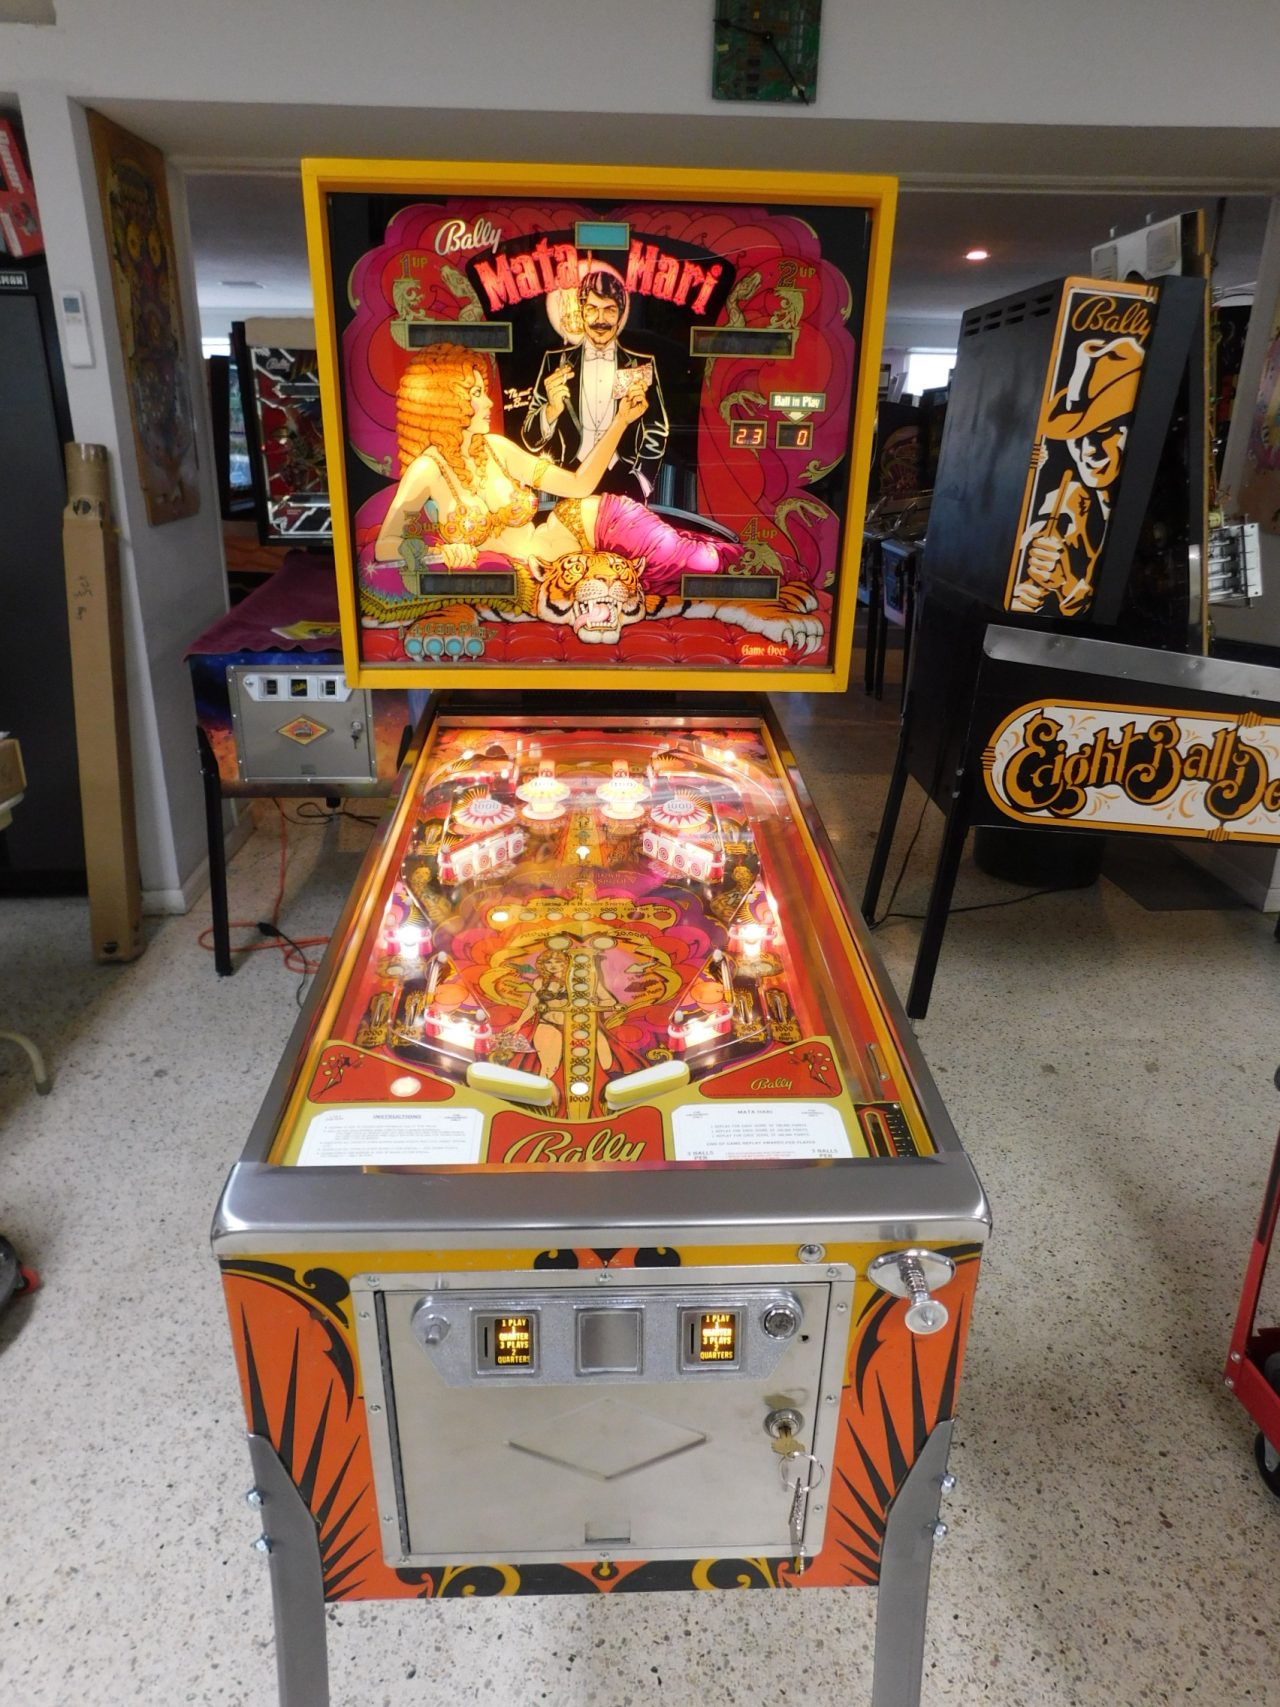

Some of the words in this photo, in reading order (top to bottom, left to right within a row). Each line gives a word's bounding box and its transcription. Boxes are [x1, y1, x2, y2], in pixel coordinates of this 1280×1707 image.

[434, 218, 502, 256] Bally
[474, 237, 581, 312] Mata
[624, 238, 723, 315] Hari
[1072, 296, 1151, 345] Bally
[774, 395, 790, 407] Ball
[792, 396, 801, 407] in
[802, 396, 820, 408] Play
[796, 430, 808, 446] 0
[741, 644, 765, 656] Game
[767, 645, 788, 656] Over
[1003, 708, 1143, 818] Eight
[1124, 717, 1237, 806] Ball
[474, 803, 499, 811] 1000
[667, 803, 692, 811] 1000
[751, 1078, 793, 1090] Bally
[503, 1128, 647, 1163] Bally
[508, 1318, 527, 1327] PLAY
[706, 1314, 711, 1323] 1
[712, 1314, 730, 1323] PLAY
[500, 1340, 505, 1349] 3
[506, 1340, 529, 1349] PLAYS
[709, 1336, 732, 1345] PLAYS
[511, 1348, 517, 1356] 2
[714, 1343, 719, 1352] 2
[700, 1351, 733, 1360] QUARTERS
